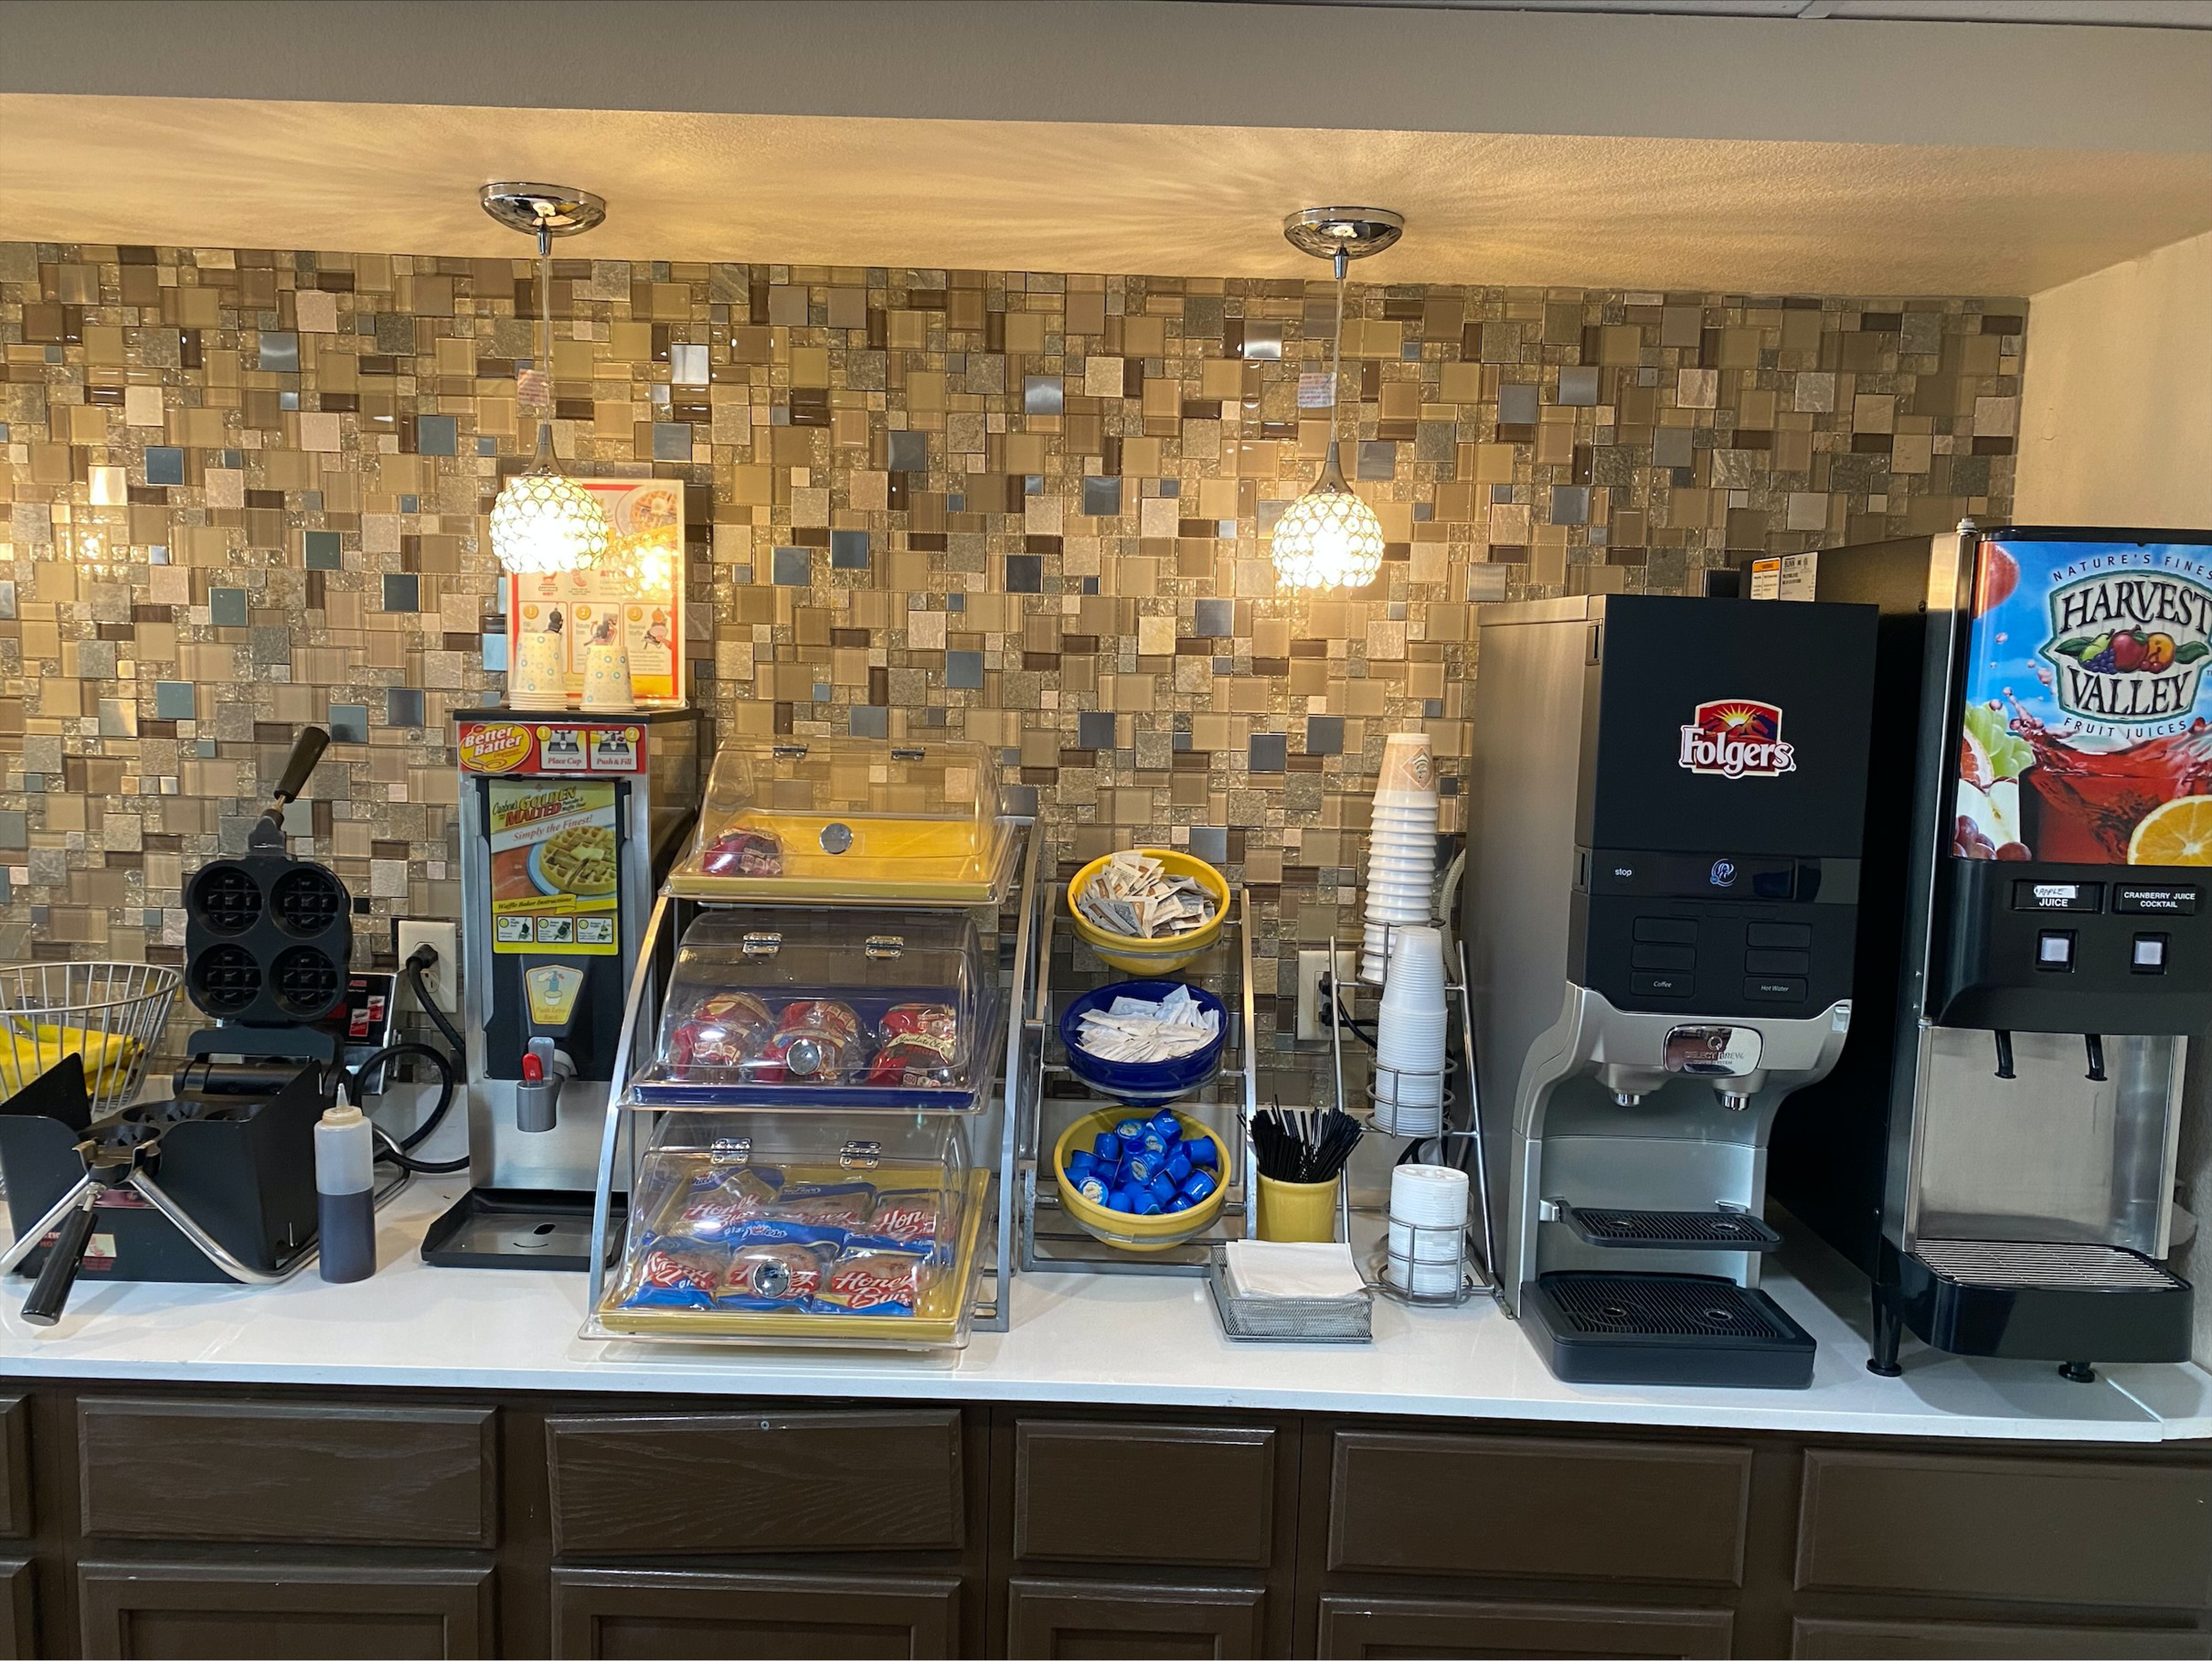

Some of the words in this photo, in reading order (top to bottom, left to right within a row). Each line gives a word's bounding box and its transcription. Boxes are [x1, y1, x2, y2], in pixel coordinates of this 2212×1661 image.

[2053, 554, 2151, 582] NATURE'S
[2059, 580, 2212, 635] HARVEST
[2067, 665, 2193, 716] VALLEY
[465, 726, 514, 748] Better
[2063, 717, 2115, 737] FRUIT
[2126, 720, 2187, 739] JUICES
[474, 735, 522, 756] Batter
[1681, 727, 1790, 774] Folgers
[519, 786, 576, 811] GOLDEN
[505, 803, 562, 827] MALTED
[514, 827, 544, 841] Simply
[546, 823, 560, 833] the
[563, 814, 593, 830] Finest!
[1615, 868, 1632, 878] stop
[2039, 898, 2069, 907] JUICE
[2124, 891, 2170, 900] CRANBERRY
[2140, 900, 2179, 908] COCKTAIL
[835, 1272, 917, 1289] Honey
